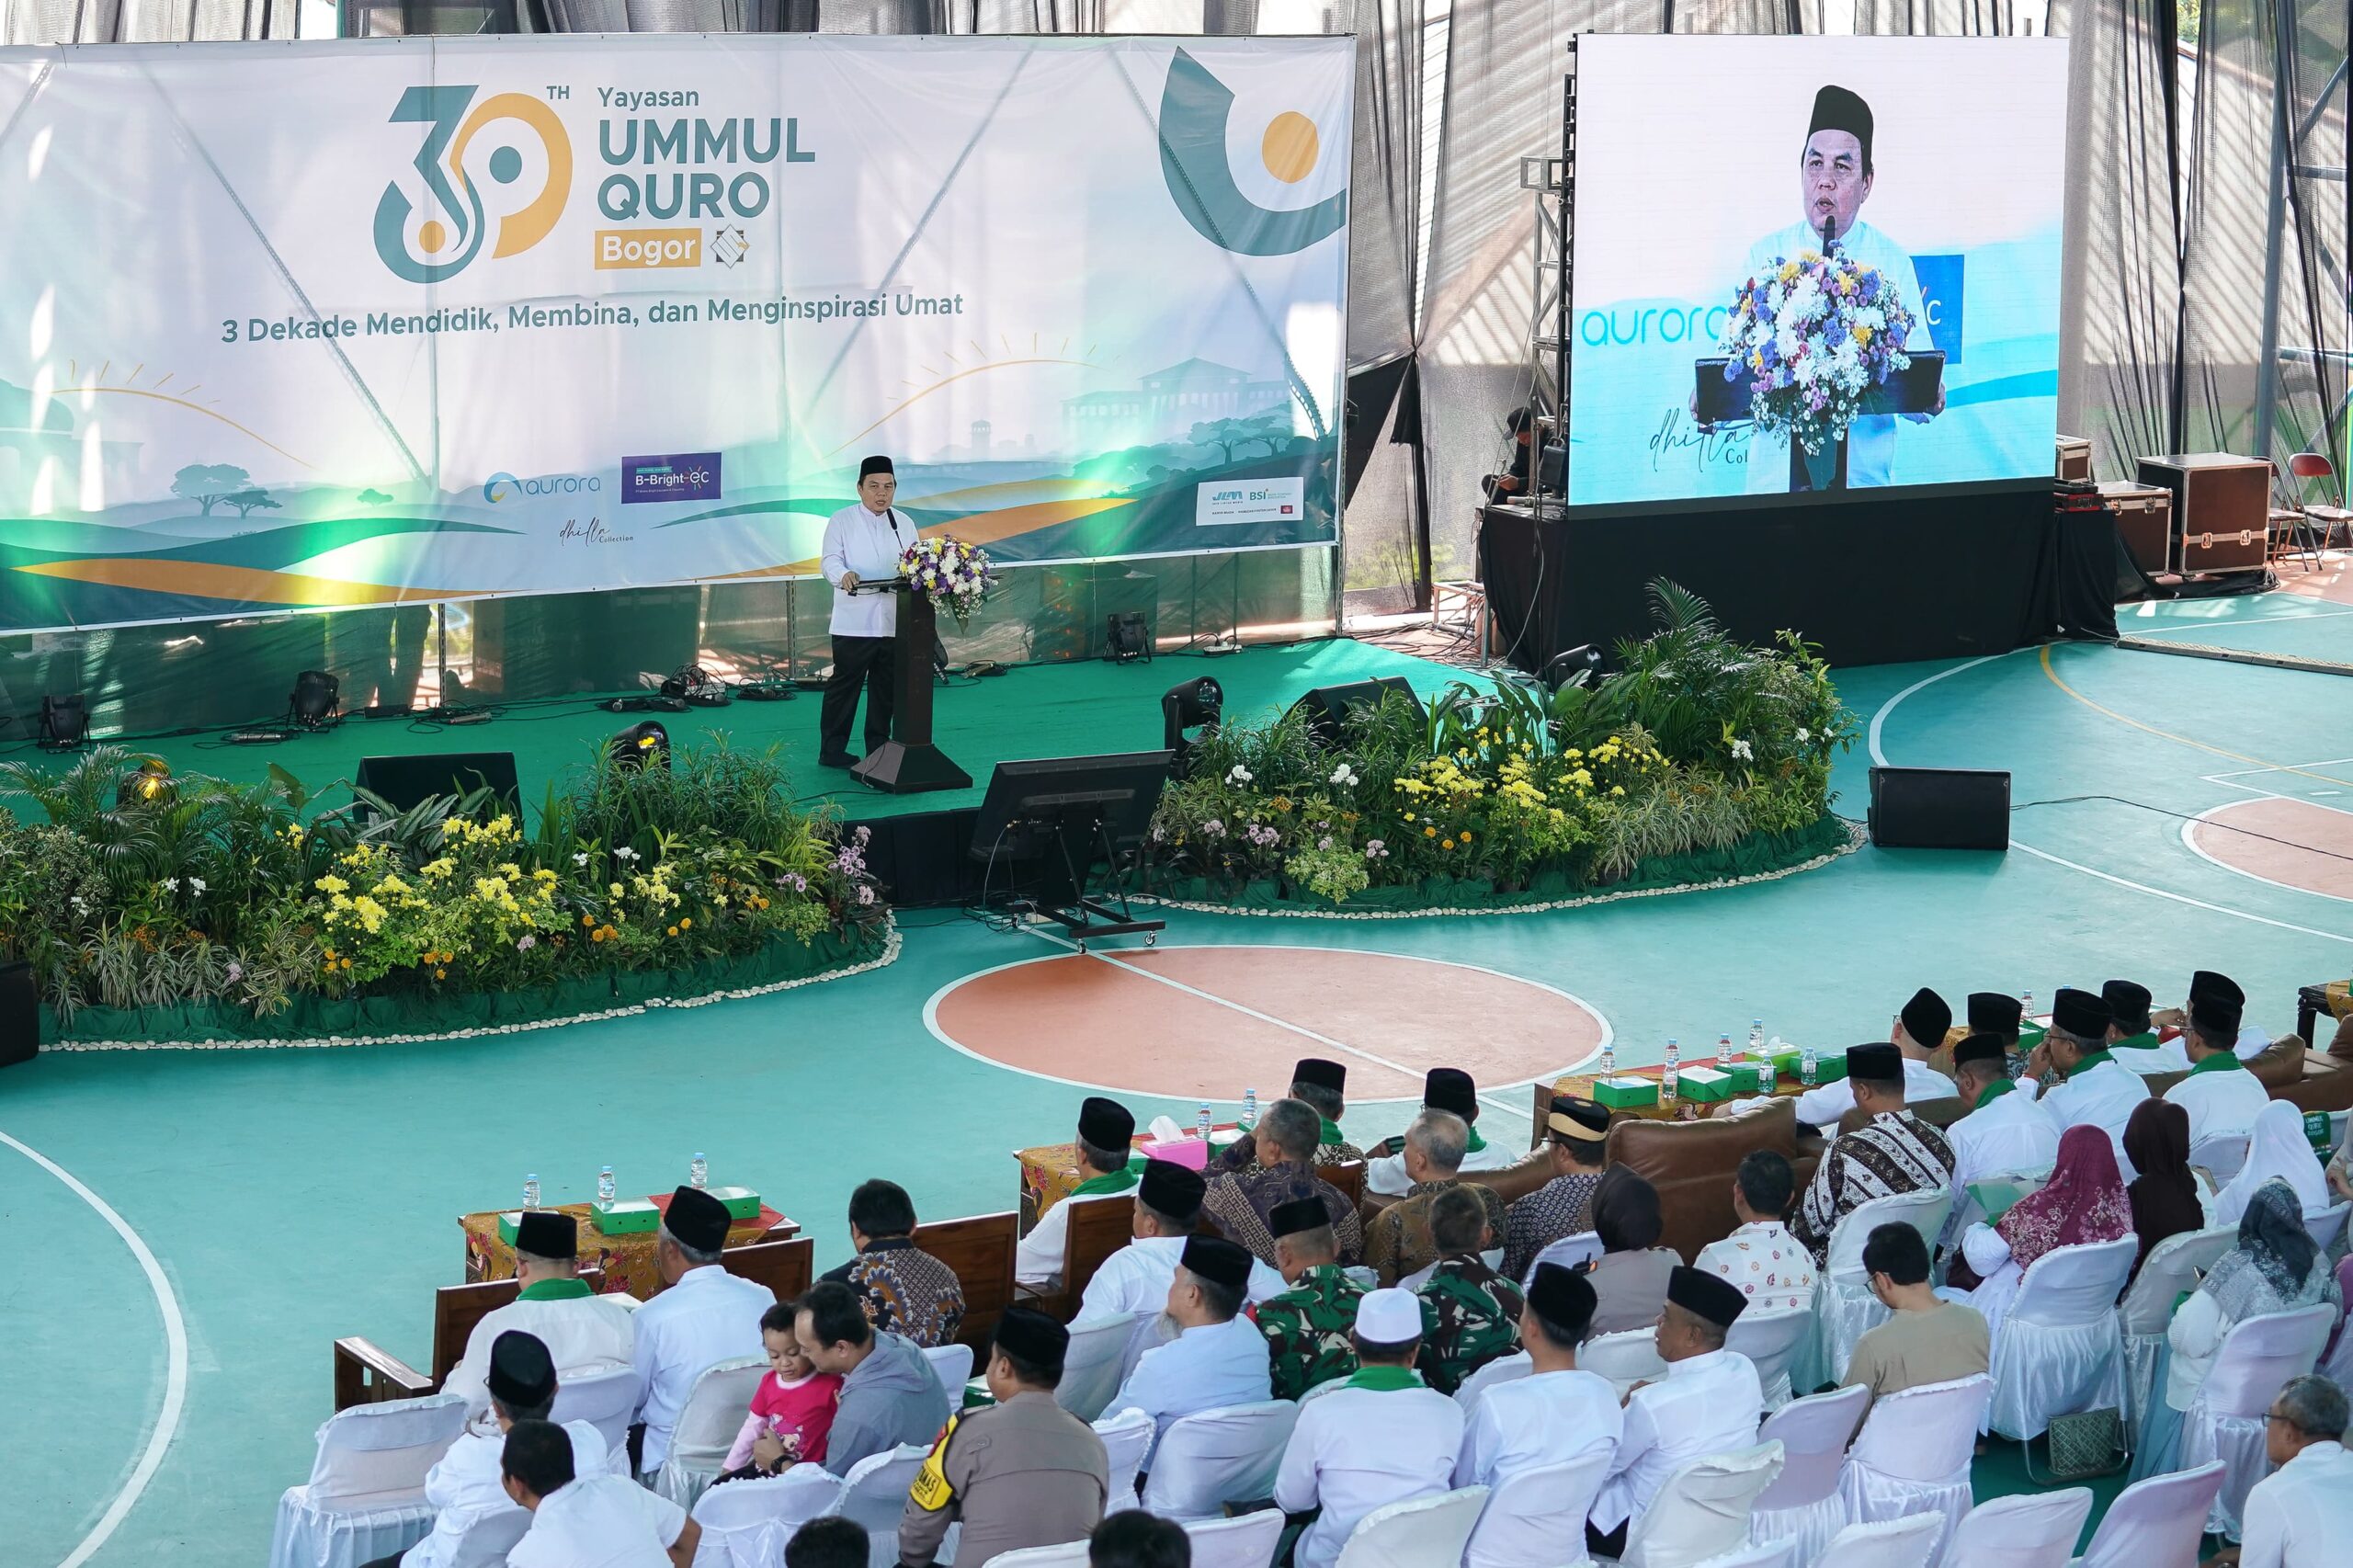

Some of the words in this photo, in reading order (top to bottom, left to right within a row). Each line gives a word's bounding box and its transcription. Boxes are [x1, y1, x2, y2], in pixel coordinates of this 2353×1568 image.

[546, 85, 571, 100] TH
[597, 86, 700, 110] Yayasan
[598, 117, 816, 165] UMMUL
[597, 171, 770, 221] QURO
[603, 234, 697, 264] Bogor
[221, 319, 239, 343] 3
[248, 314, 358, 342] Dekade
[367, 306, 499, 335] Mendidik,
[508, 301, 640, 328] Membina,
[648, 300, 699, 324] dan
[708, 293, 888, 324] Menginspirasi
[895, 293, 964, 316] Umat
[525, 476, 601, 496] aurora
[1250, 491, 1267, 501] BSI
[599, 535, 634, 543] Collection
